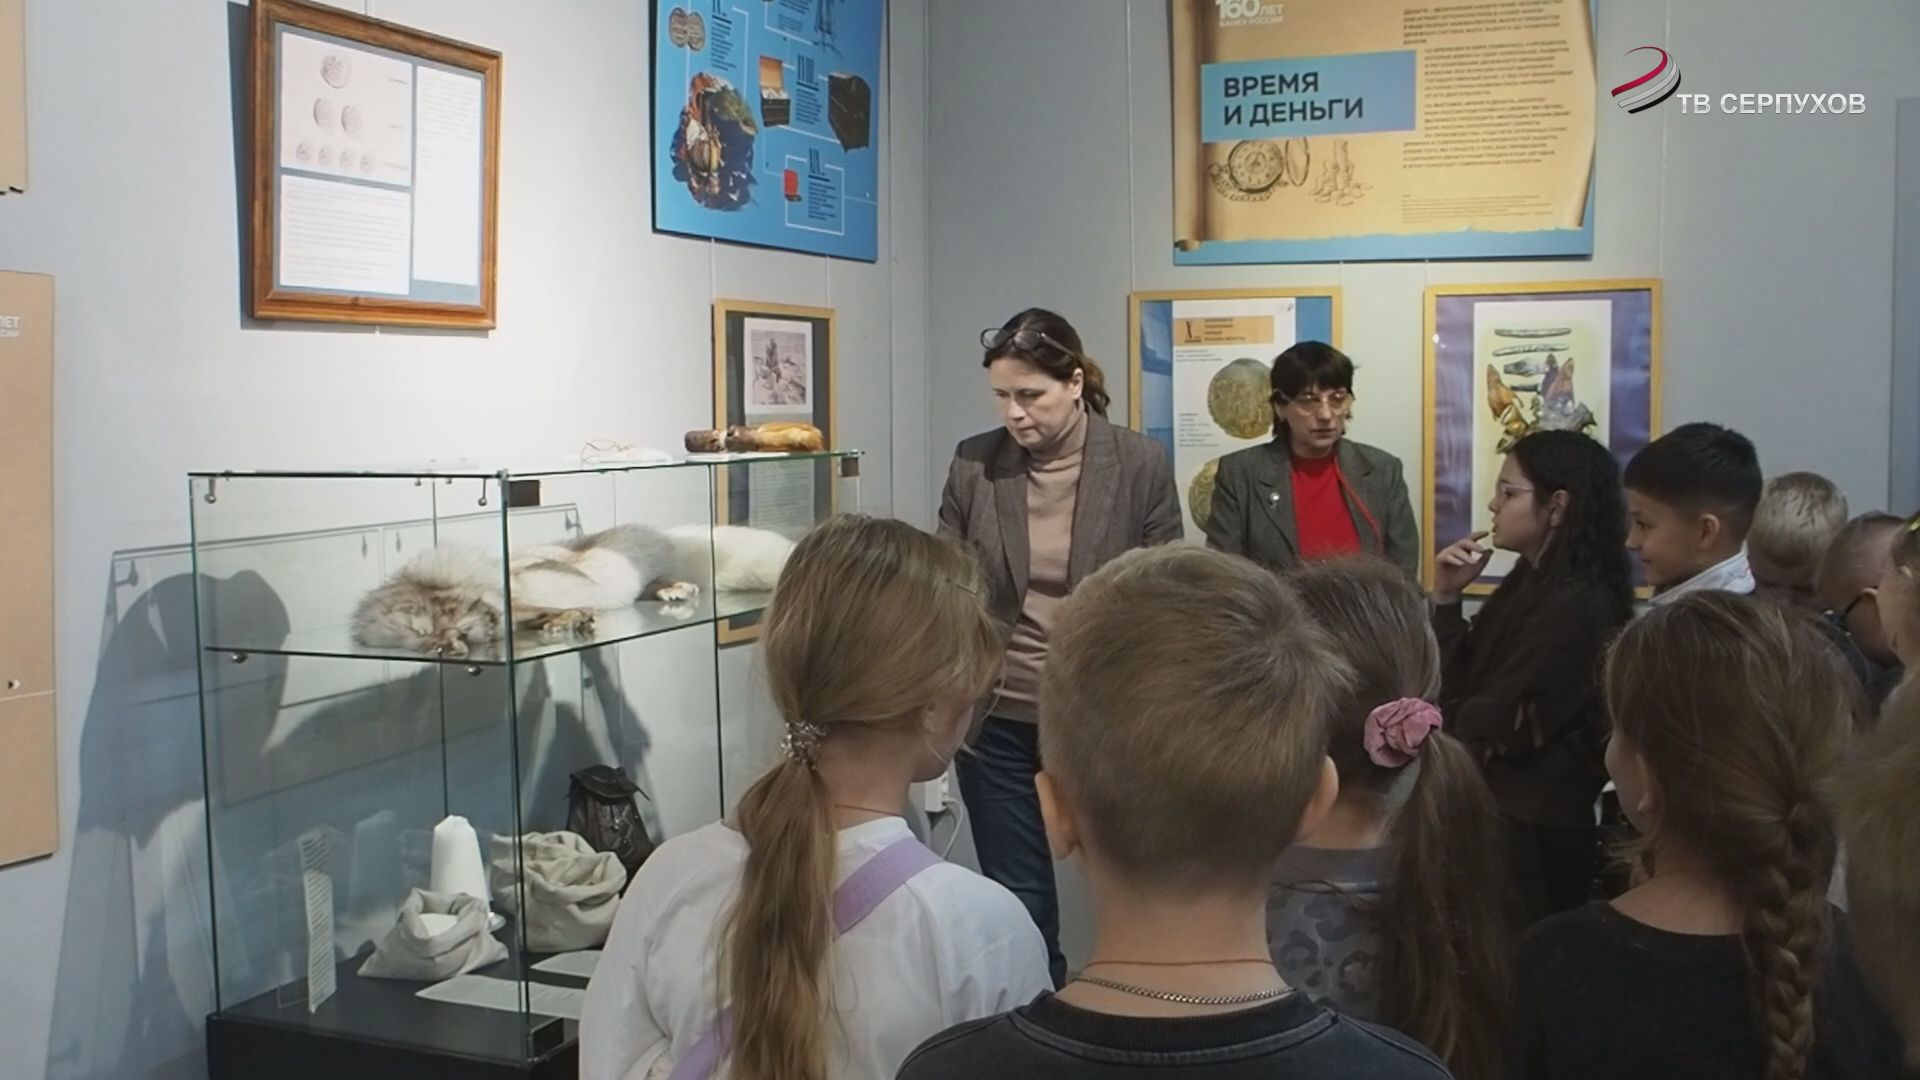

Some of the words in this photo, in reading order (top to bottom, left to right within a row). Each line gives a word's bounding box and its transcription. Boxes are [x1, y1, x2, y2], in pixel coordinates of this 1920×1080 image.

[1215, 0, 1260, 19] 160
[1224, 71, 1319, 98] ВРЕМЯ
[1224, 105, 1242, 126] И
[1249, 97, 1363, 127] ДЕНЬГИ
